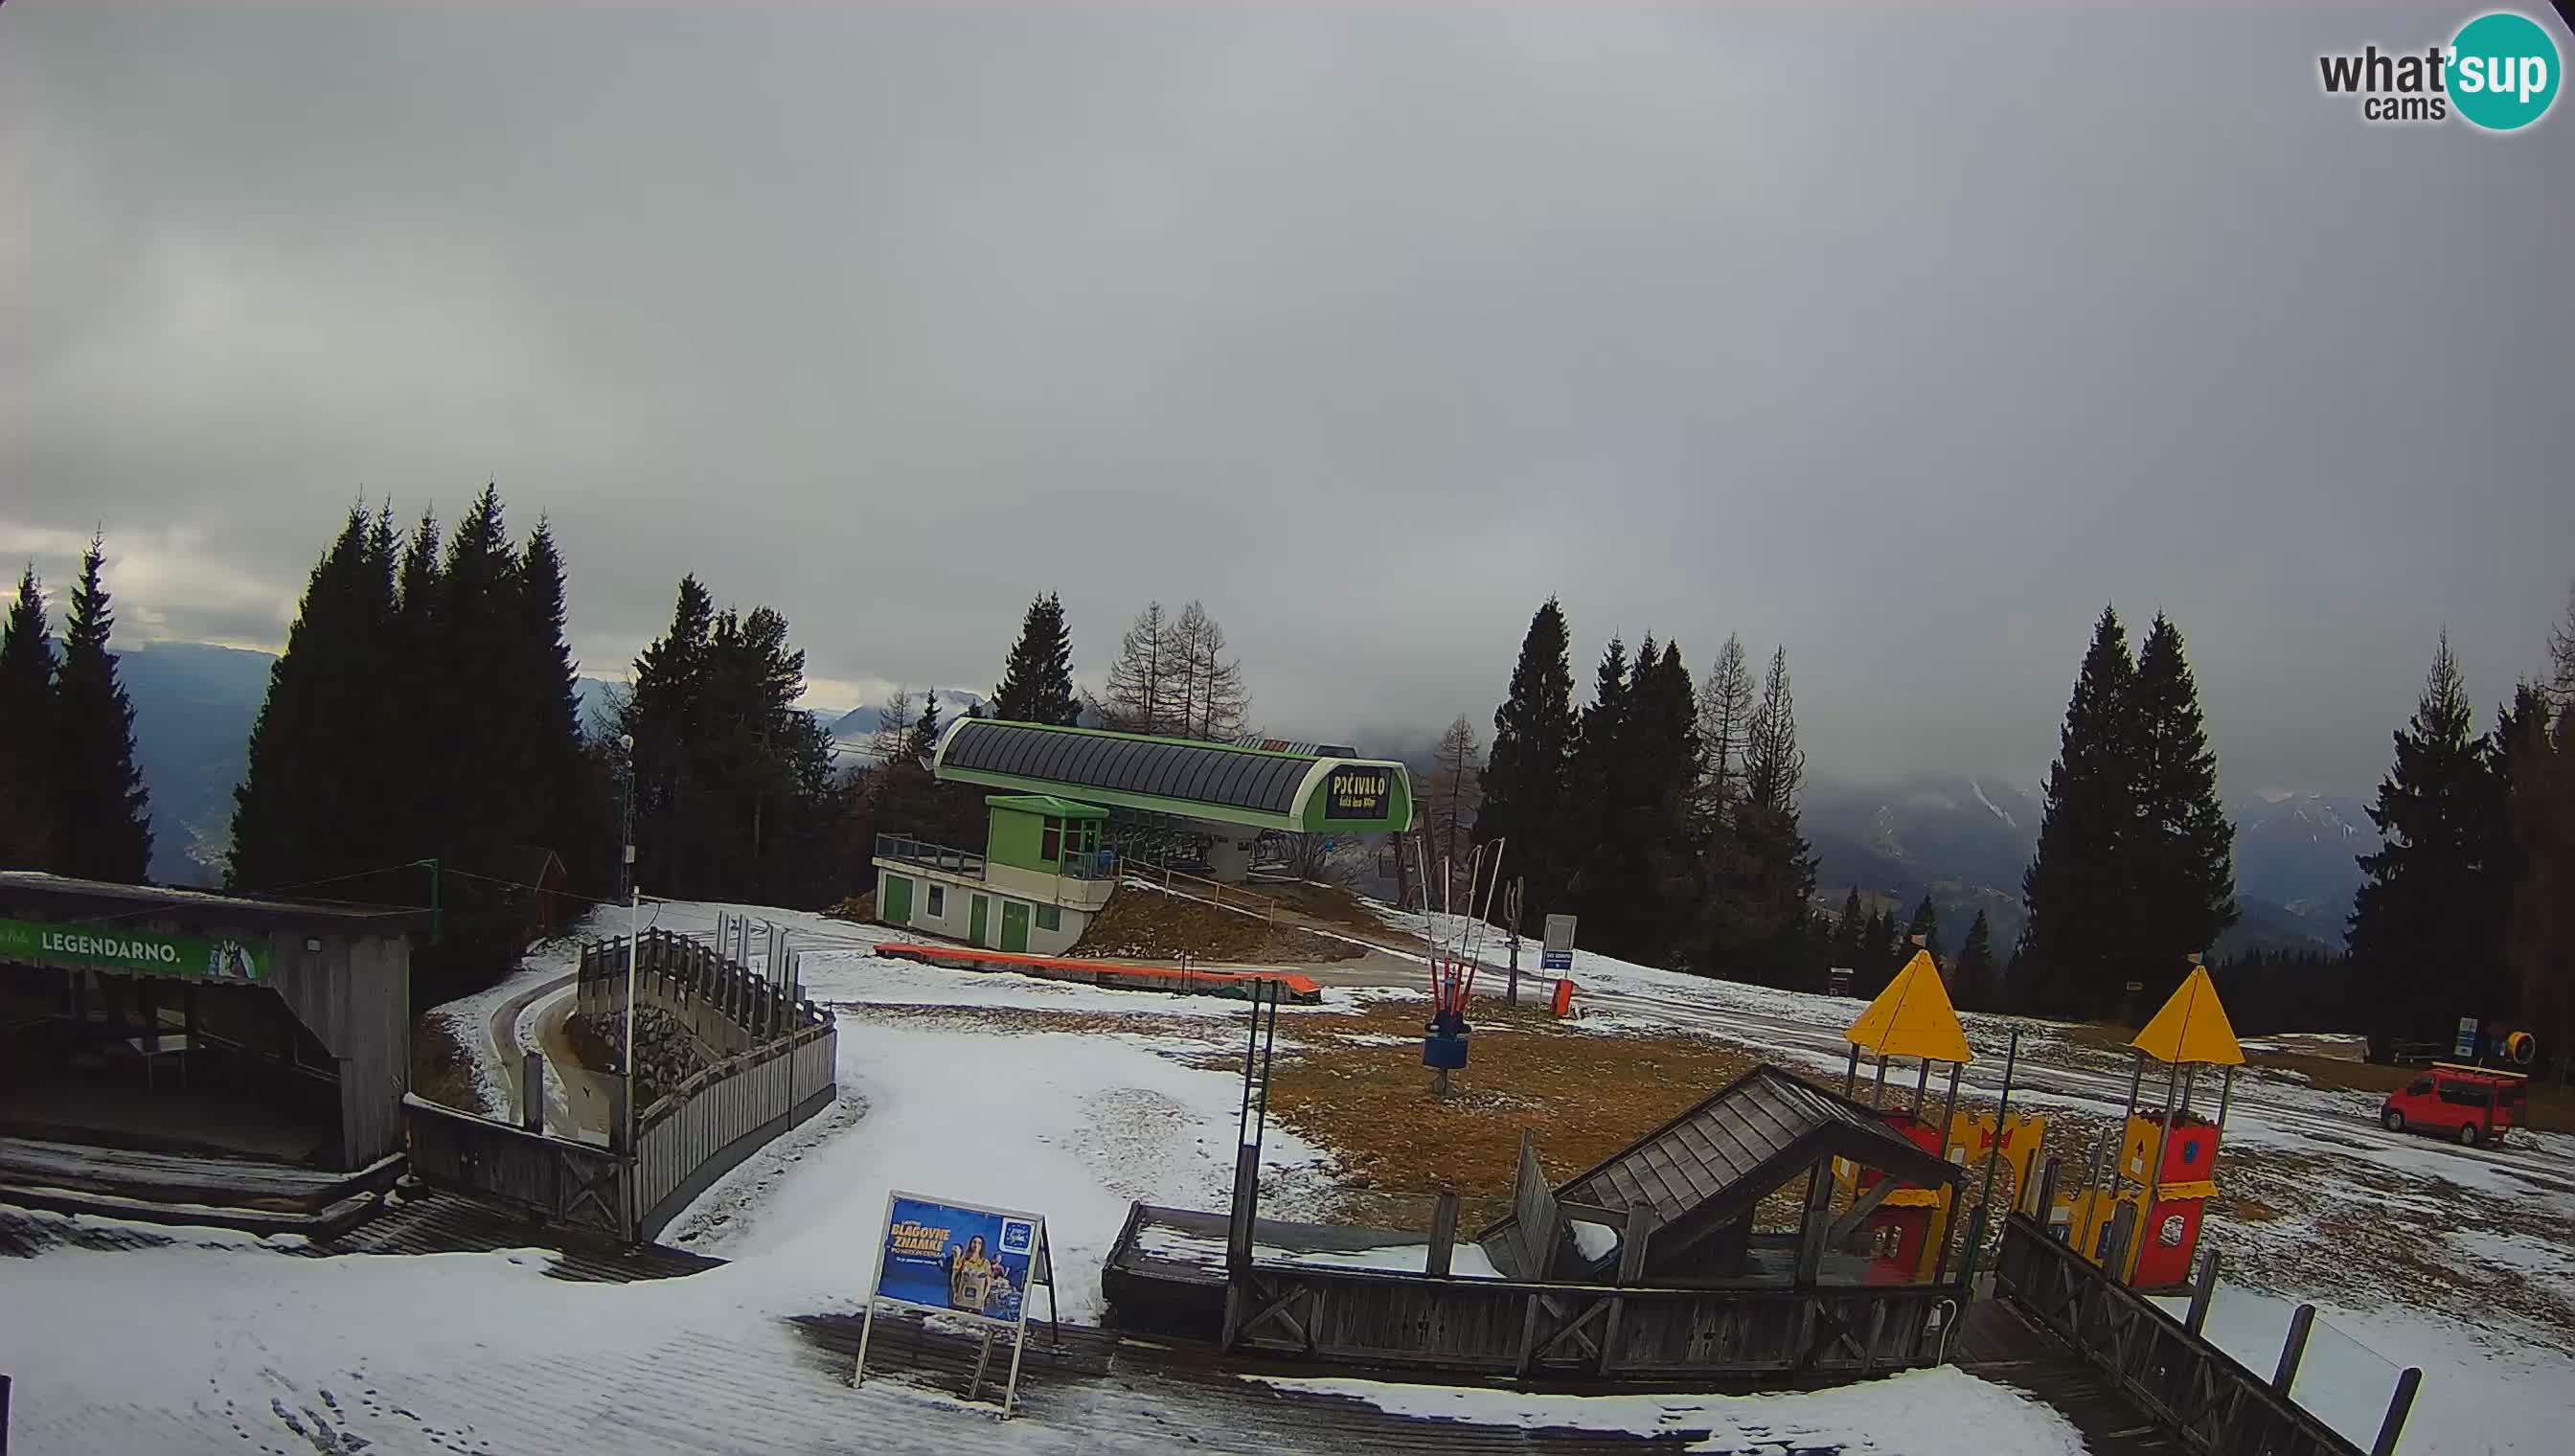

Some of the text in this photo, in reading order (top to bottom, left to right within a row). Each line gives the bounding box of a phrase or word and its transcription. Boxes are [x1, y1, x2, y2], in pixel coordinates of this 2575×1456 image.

[41, 931, 181, 964] LEGENDARNO.
[891, 1223, 950, 1241] BLAGOVNE
[893, 1236, 944, 1252] ZNAMKE
